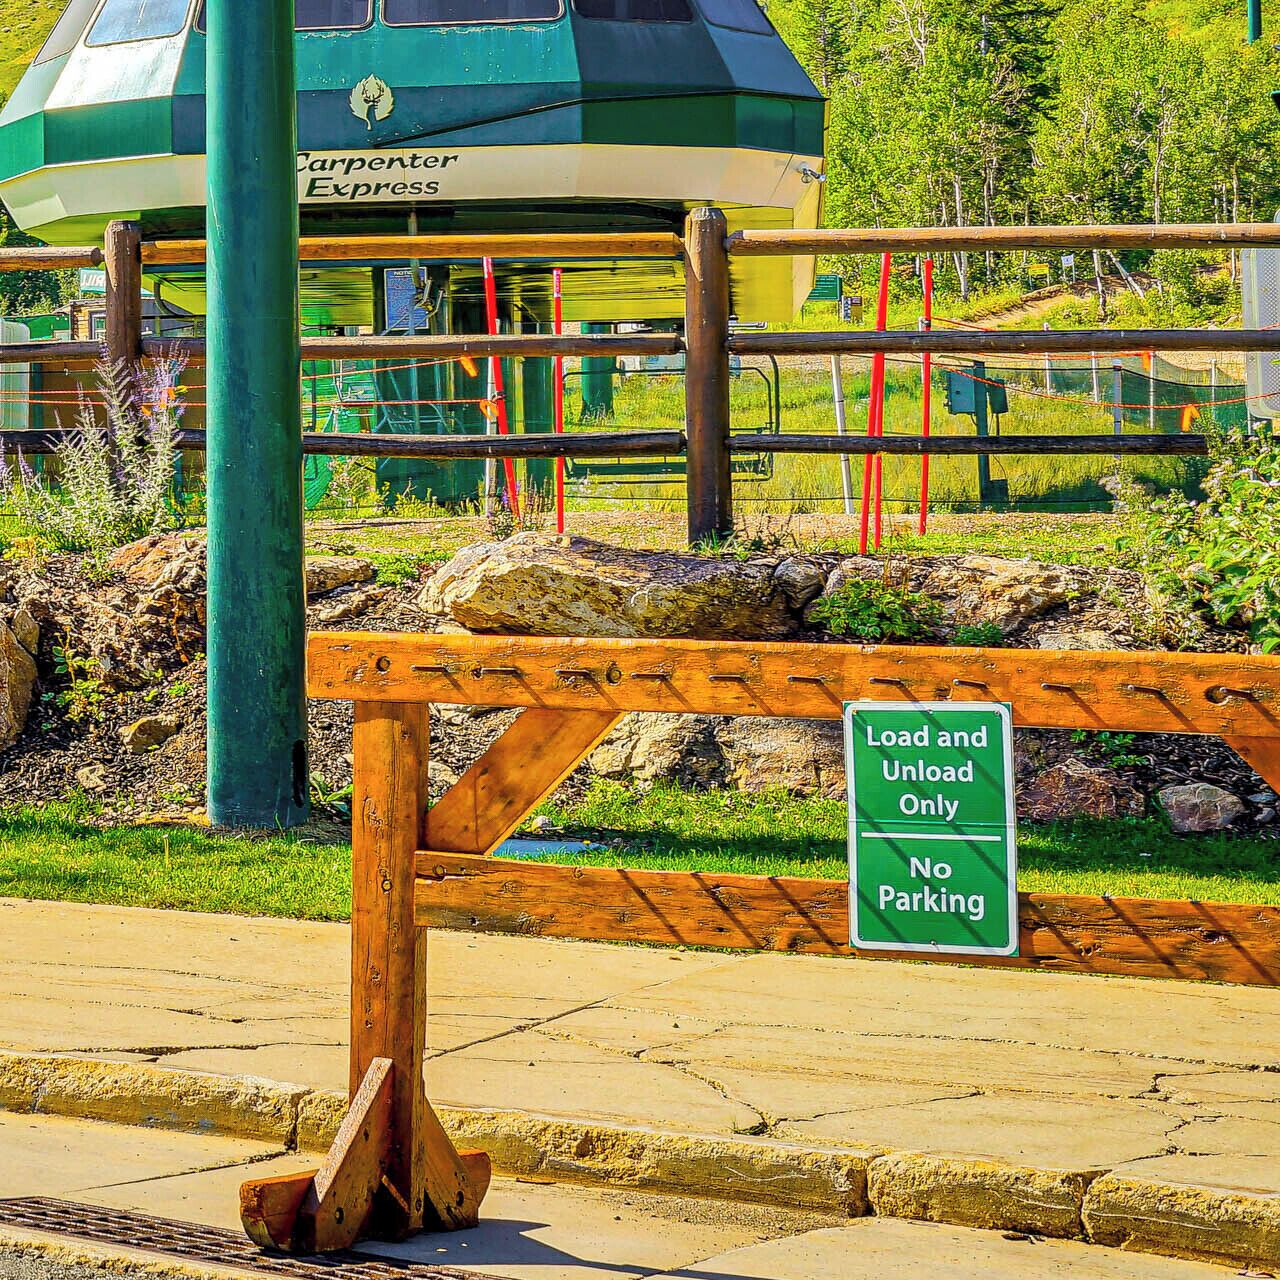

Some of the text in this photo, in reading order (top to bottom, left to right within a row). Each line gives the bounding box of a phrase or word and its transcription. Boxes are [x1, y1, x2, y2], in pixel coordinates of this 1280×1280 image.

[296, 152, 459, 175] Carpenter
[305, 177, 440, 200] Express
[866, 725, 988, 748] Load and
[882, 759, 974, 783] Unload
[899, 793, 959, 821] Only
[910, 857, 952, 879] No
[879, 885, 985, 921] Parking
